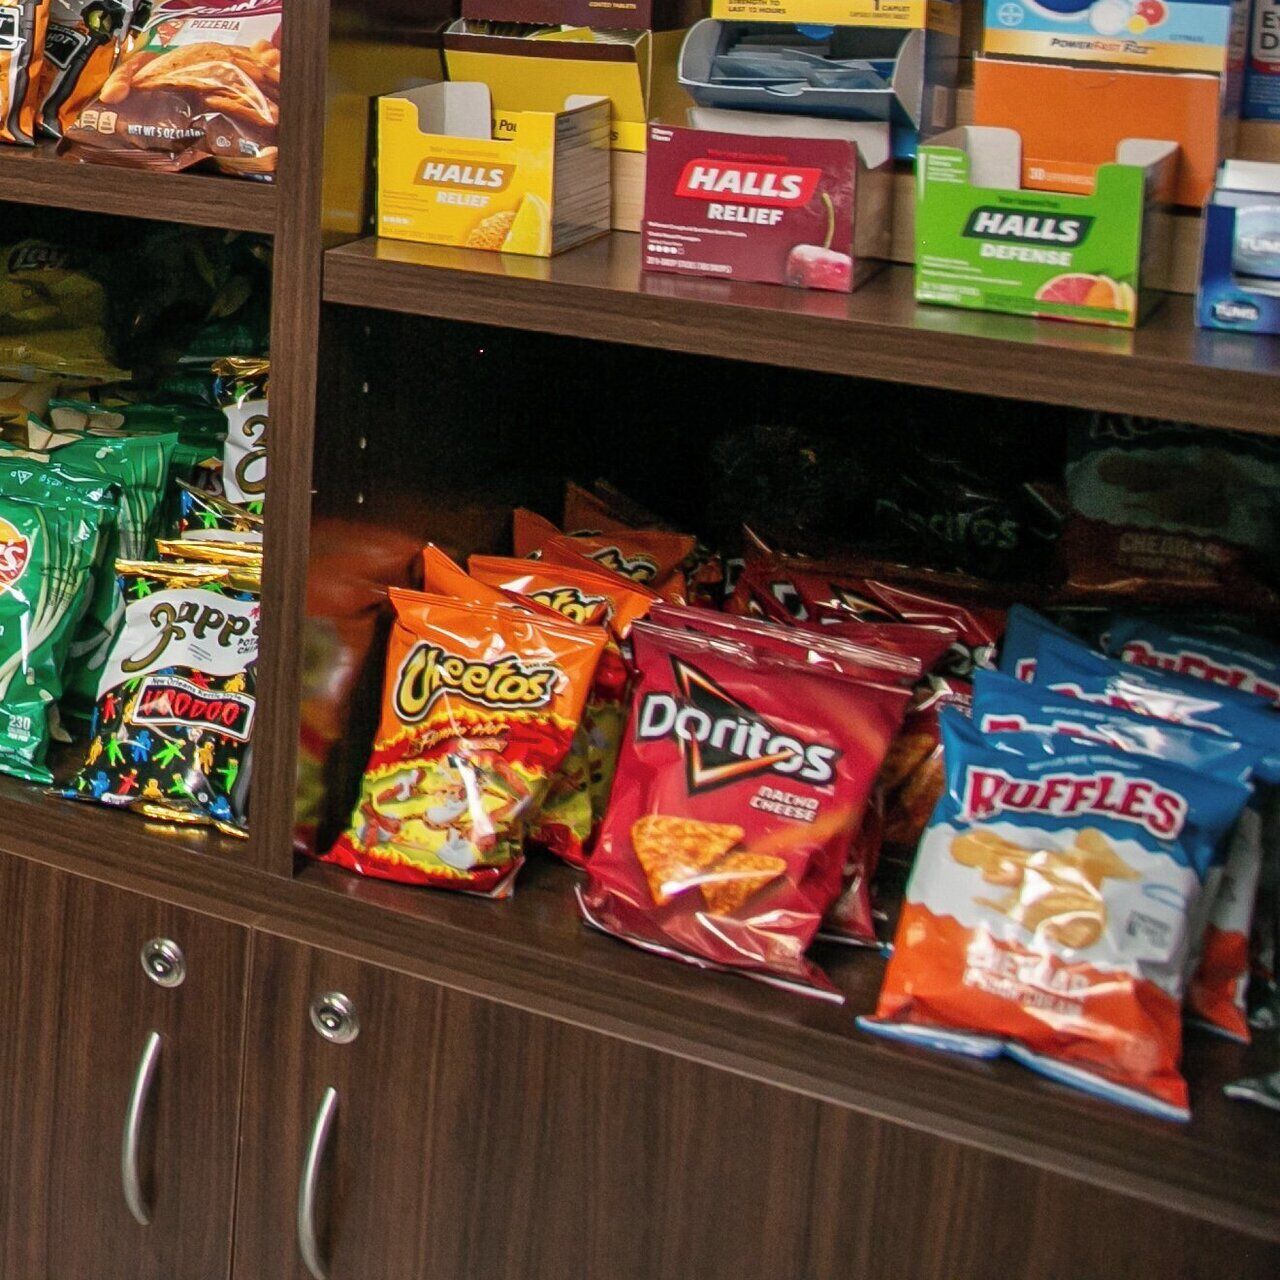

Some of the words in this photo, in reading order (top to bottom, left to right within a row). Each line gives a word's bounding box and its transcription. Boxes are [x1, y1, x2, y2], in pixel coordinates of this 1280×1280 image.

[189, 19, 241, 32] PIZZERIA
[422, 162, 505, 188] HALLS
[687, 165, 804, 200] HALLS
[435, 191, 491, 208] RELIEF
[707, 203, 784, 226] RELIEF
[972, 211, 1081, 243] HALLS
[979, 242, 1073, 267] DEFENSE
[150, 676, 166, 685] New
[166, 677, 196, 693] Orleans
[397, 643, 552, 718] Cheetos
[8, 714, 32, 729] 230
[640, 692, 838, 784] Doritos
[749, 795, 818, 822] CHEESE
[759, 785, 820, 811] NACHO
[963, 766, 1186, 840] RUFFLES
